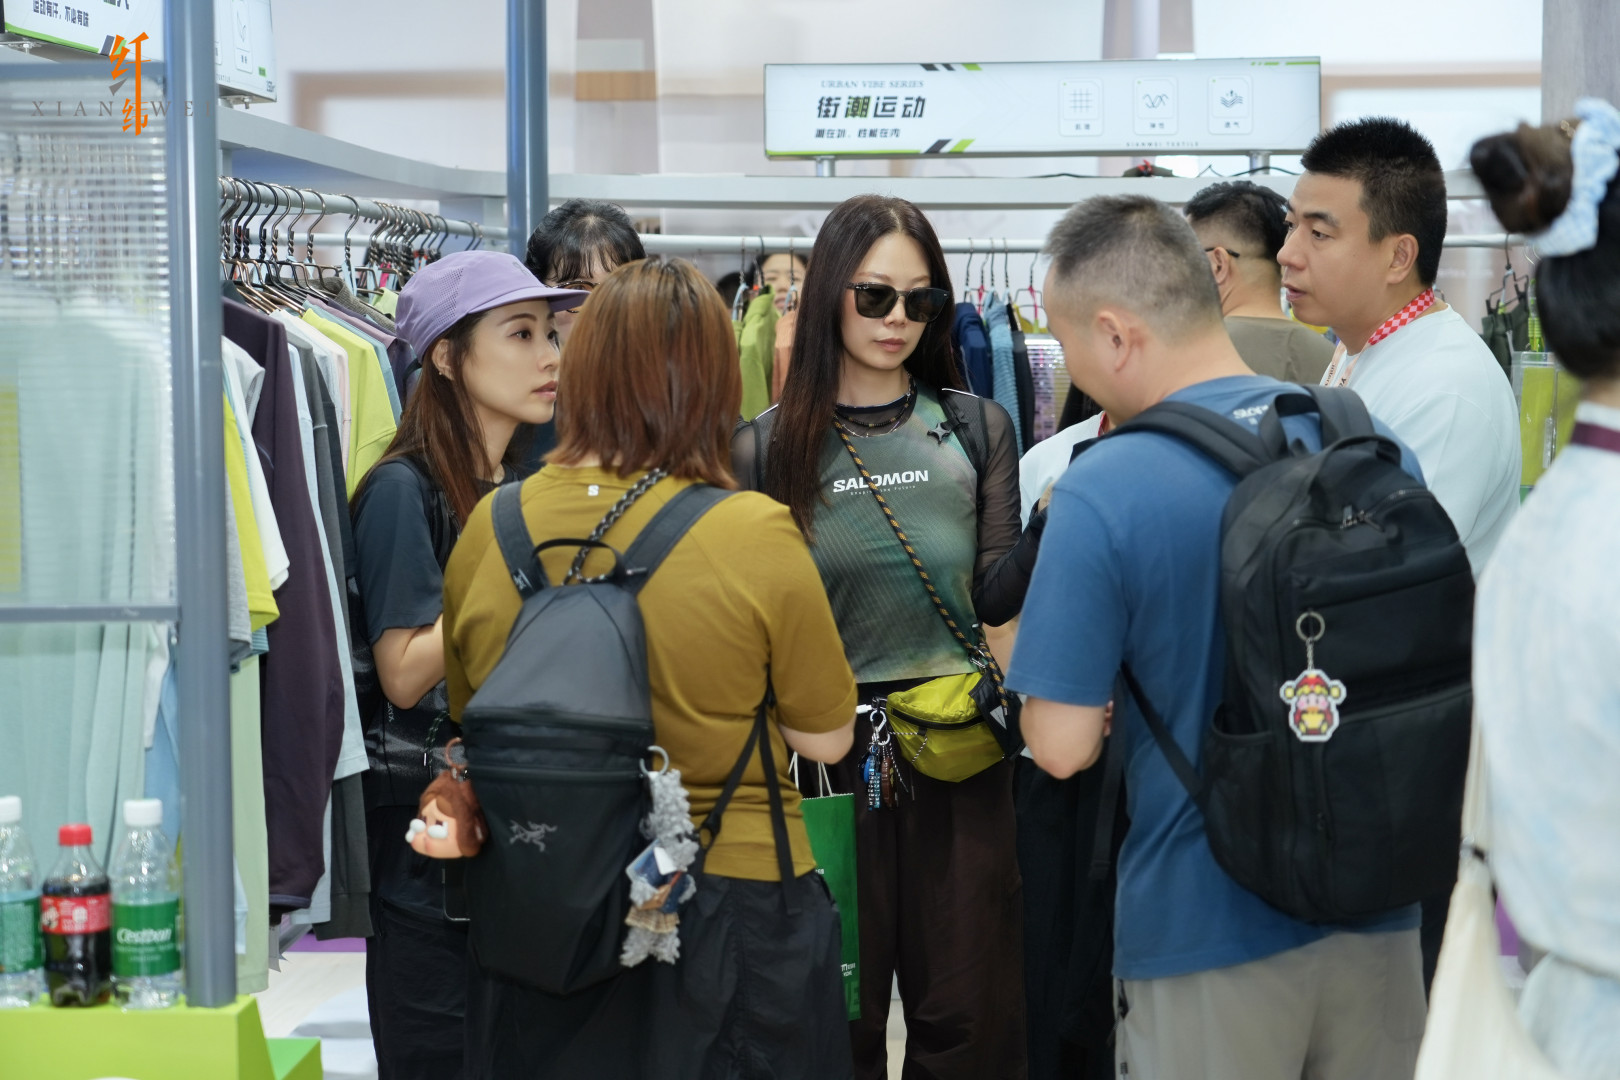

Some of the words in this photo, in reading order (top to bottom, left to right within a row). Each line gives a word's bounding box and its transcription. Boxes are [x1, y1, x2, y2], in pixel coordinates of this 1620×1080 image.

[821, 80, 859, 89] URBAN
[862, 80, 886, 89] VIBE
[889, 80, 925, 89] SERIES
[817, 96, 926, 118] 街潮运动
[833, 470, 929, 493] SALOMON
